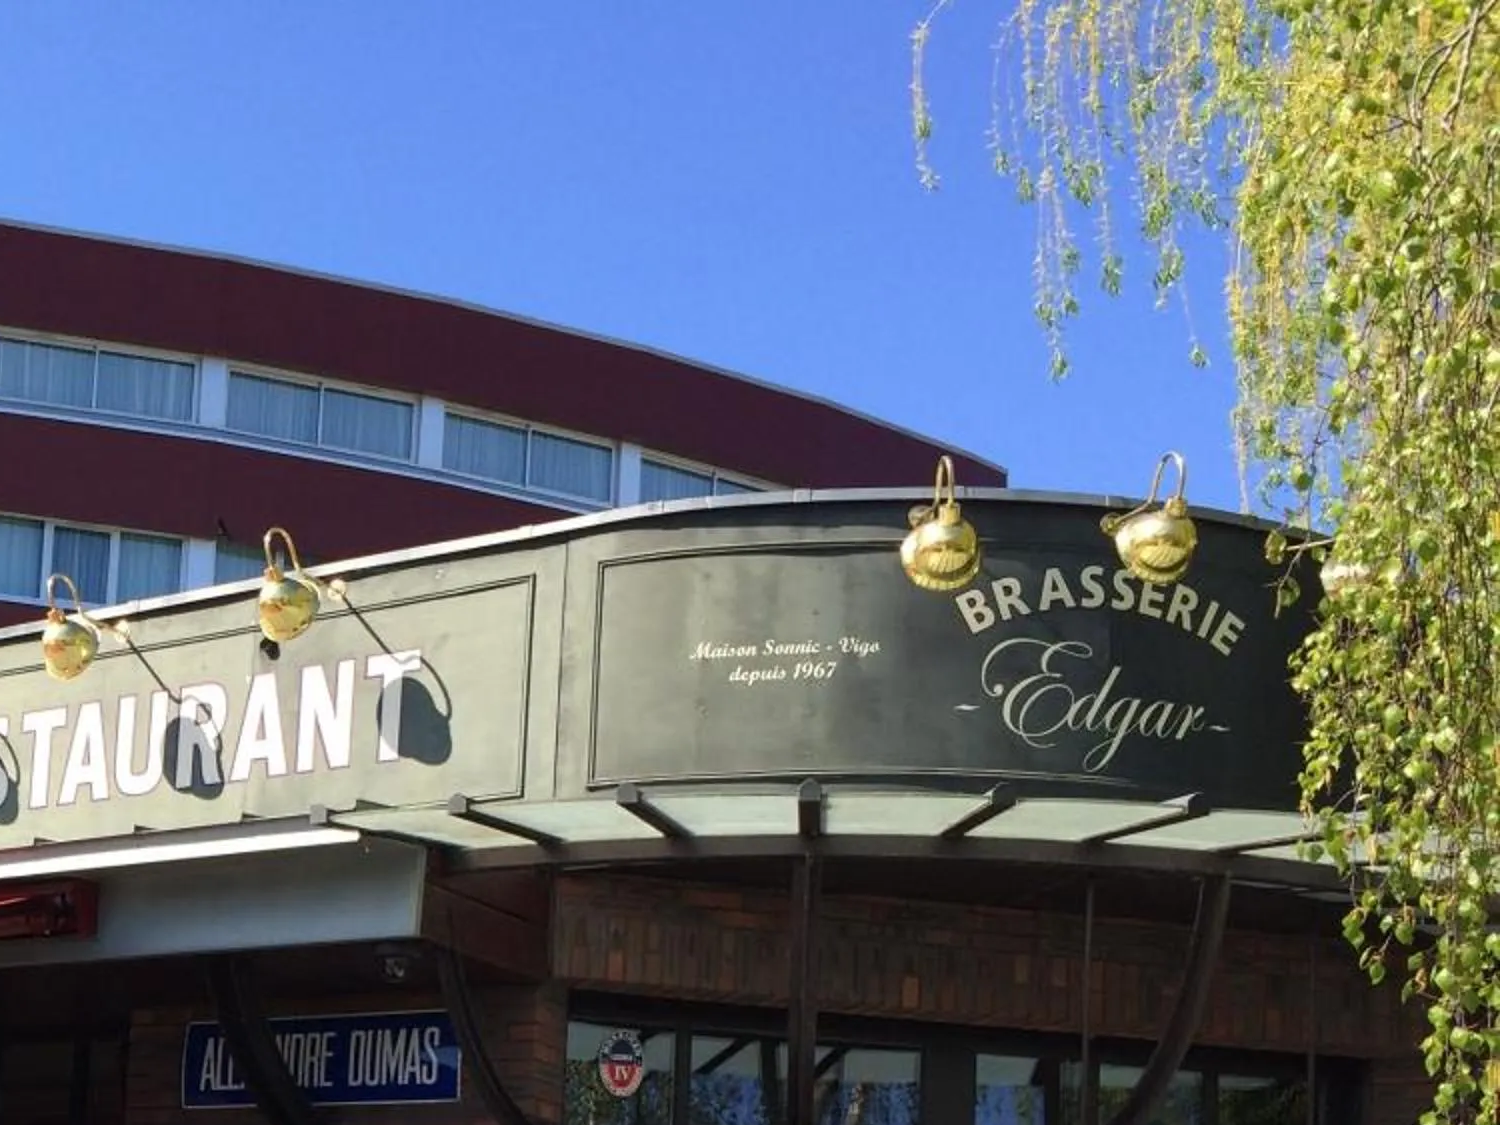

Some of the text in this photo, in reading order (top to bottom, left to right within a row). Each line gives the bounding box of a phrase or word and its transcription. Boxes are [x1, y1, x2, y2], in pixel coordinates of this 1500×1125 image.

[955, 567, 1245, 656] BRASSERIE
[690, 642, 757, 660] Maison
[762, 638, 821, 657] Sonnic
[838, 636, 881, 658] Vigo
[728, 661, 837, 685] depuis 1967
[981, 638, 1205, 772] Edgar
[200, 1026, 440, 1091] ALNDRE DUMAS
